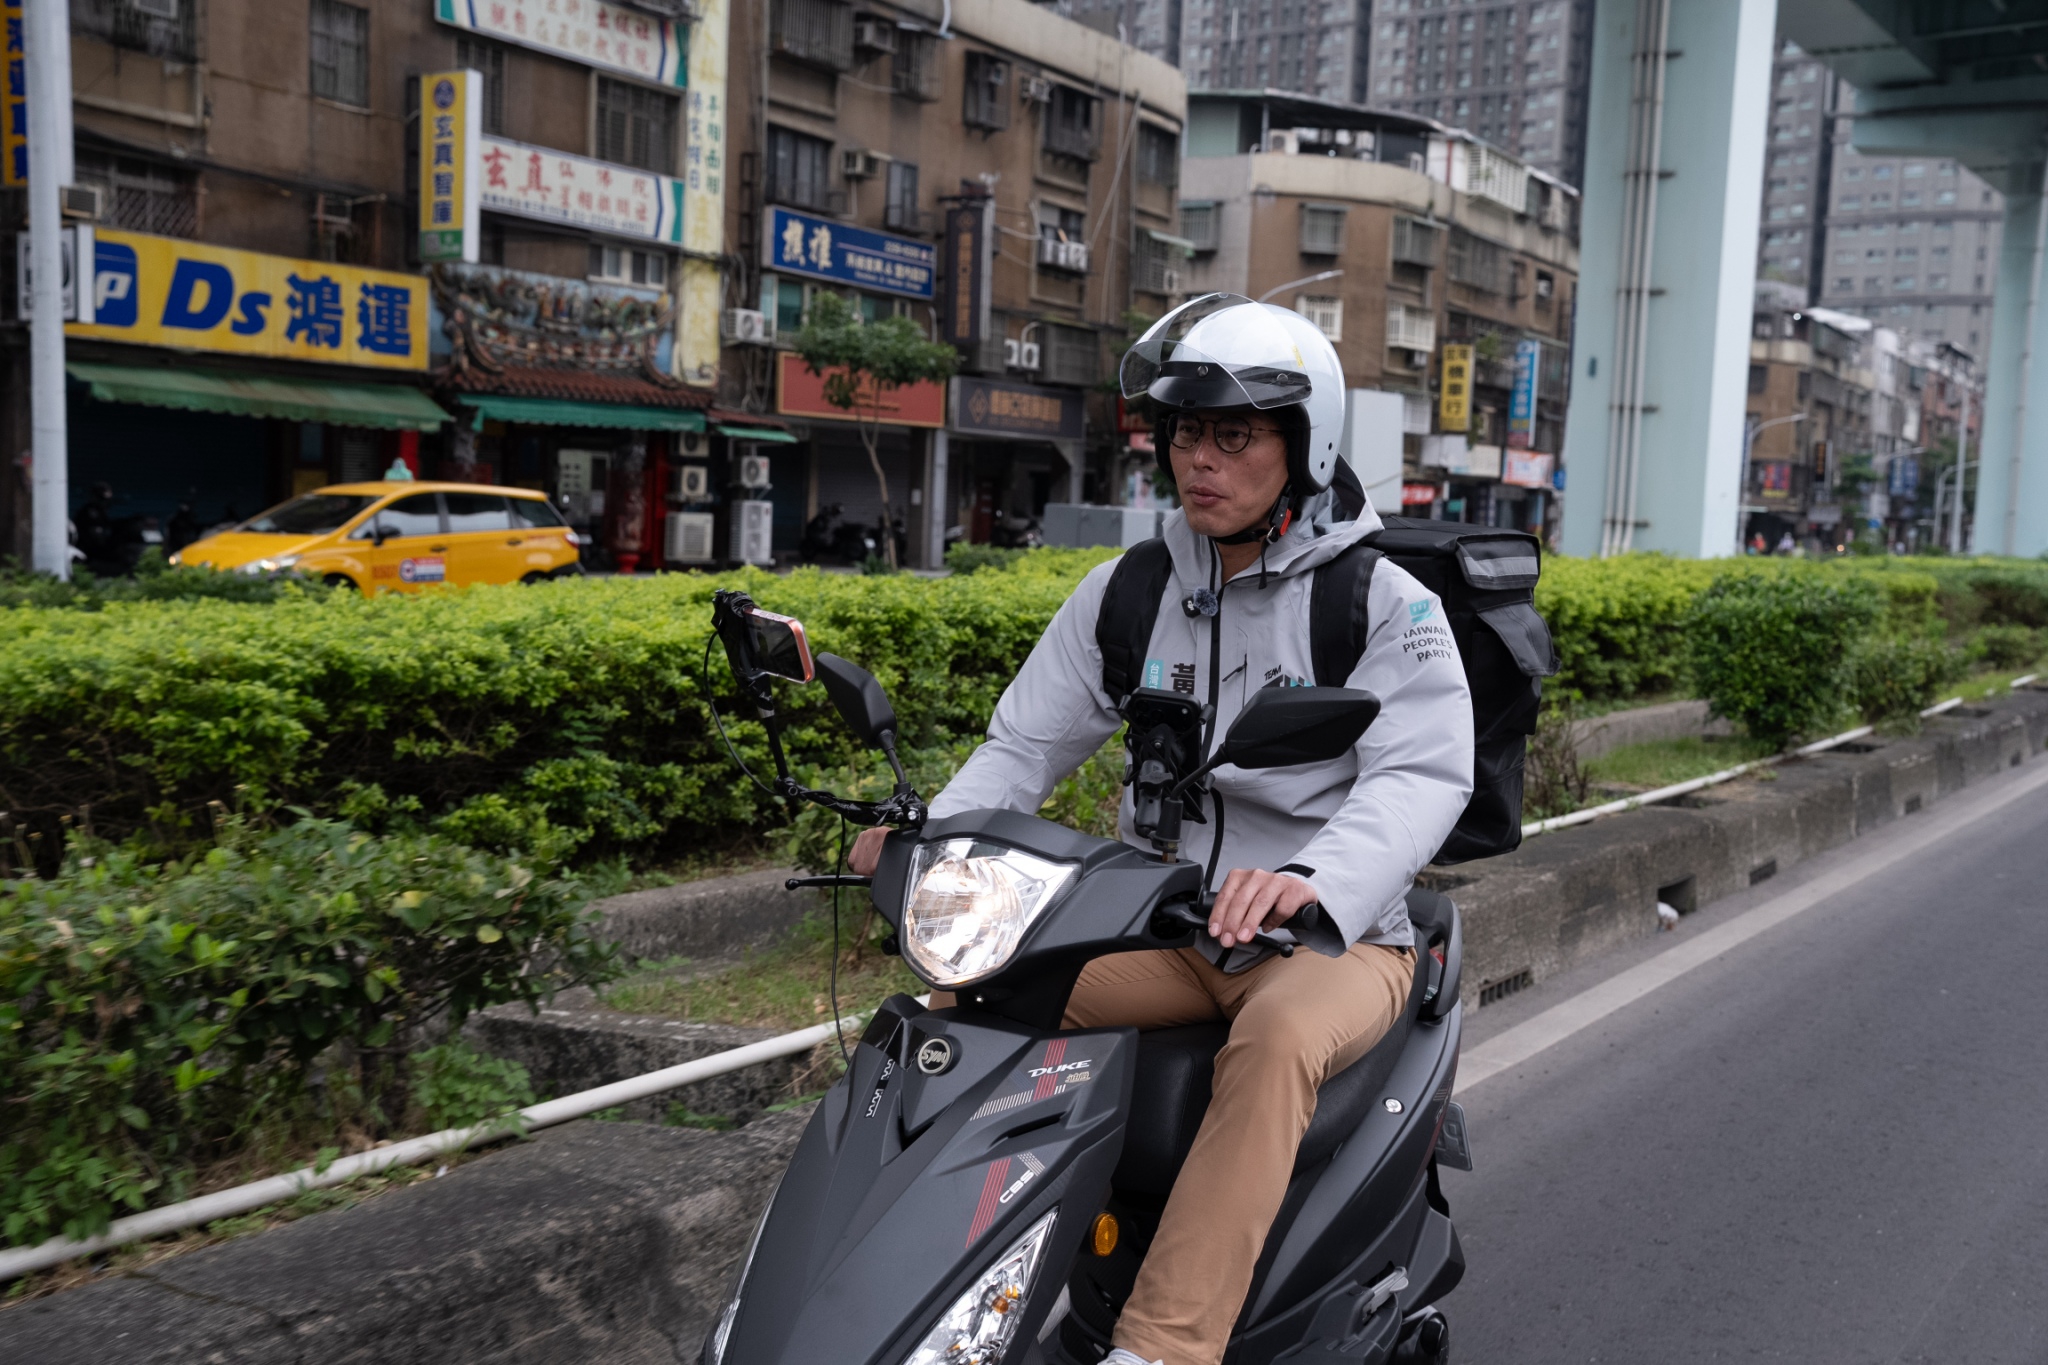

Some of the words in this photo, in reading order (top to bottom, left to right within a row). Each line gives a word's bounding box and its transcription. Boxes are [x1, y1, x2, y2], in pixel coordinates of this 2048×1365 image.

[432, 114, 455, 224] 玄真智庫
[285, 272, 412, 356] 鴻運
[1402, 637, 1453, 653] PEOPLE'S
[1416, 649, 1451, 662] PARTY
[1264, 664, 1282, 681] TEAM
[921, 1049, 947, 1064] SYM
[1027, 1059, 1092, 1078] DUKE
[999, 1169, 1035, 1204] CBS
